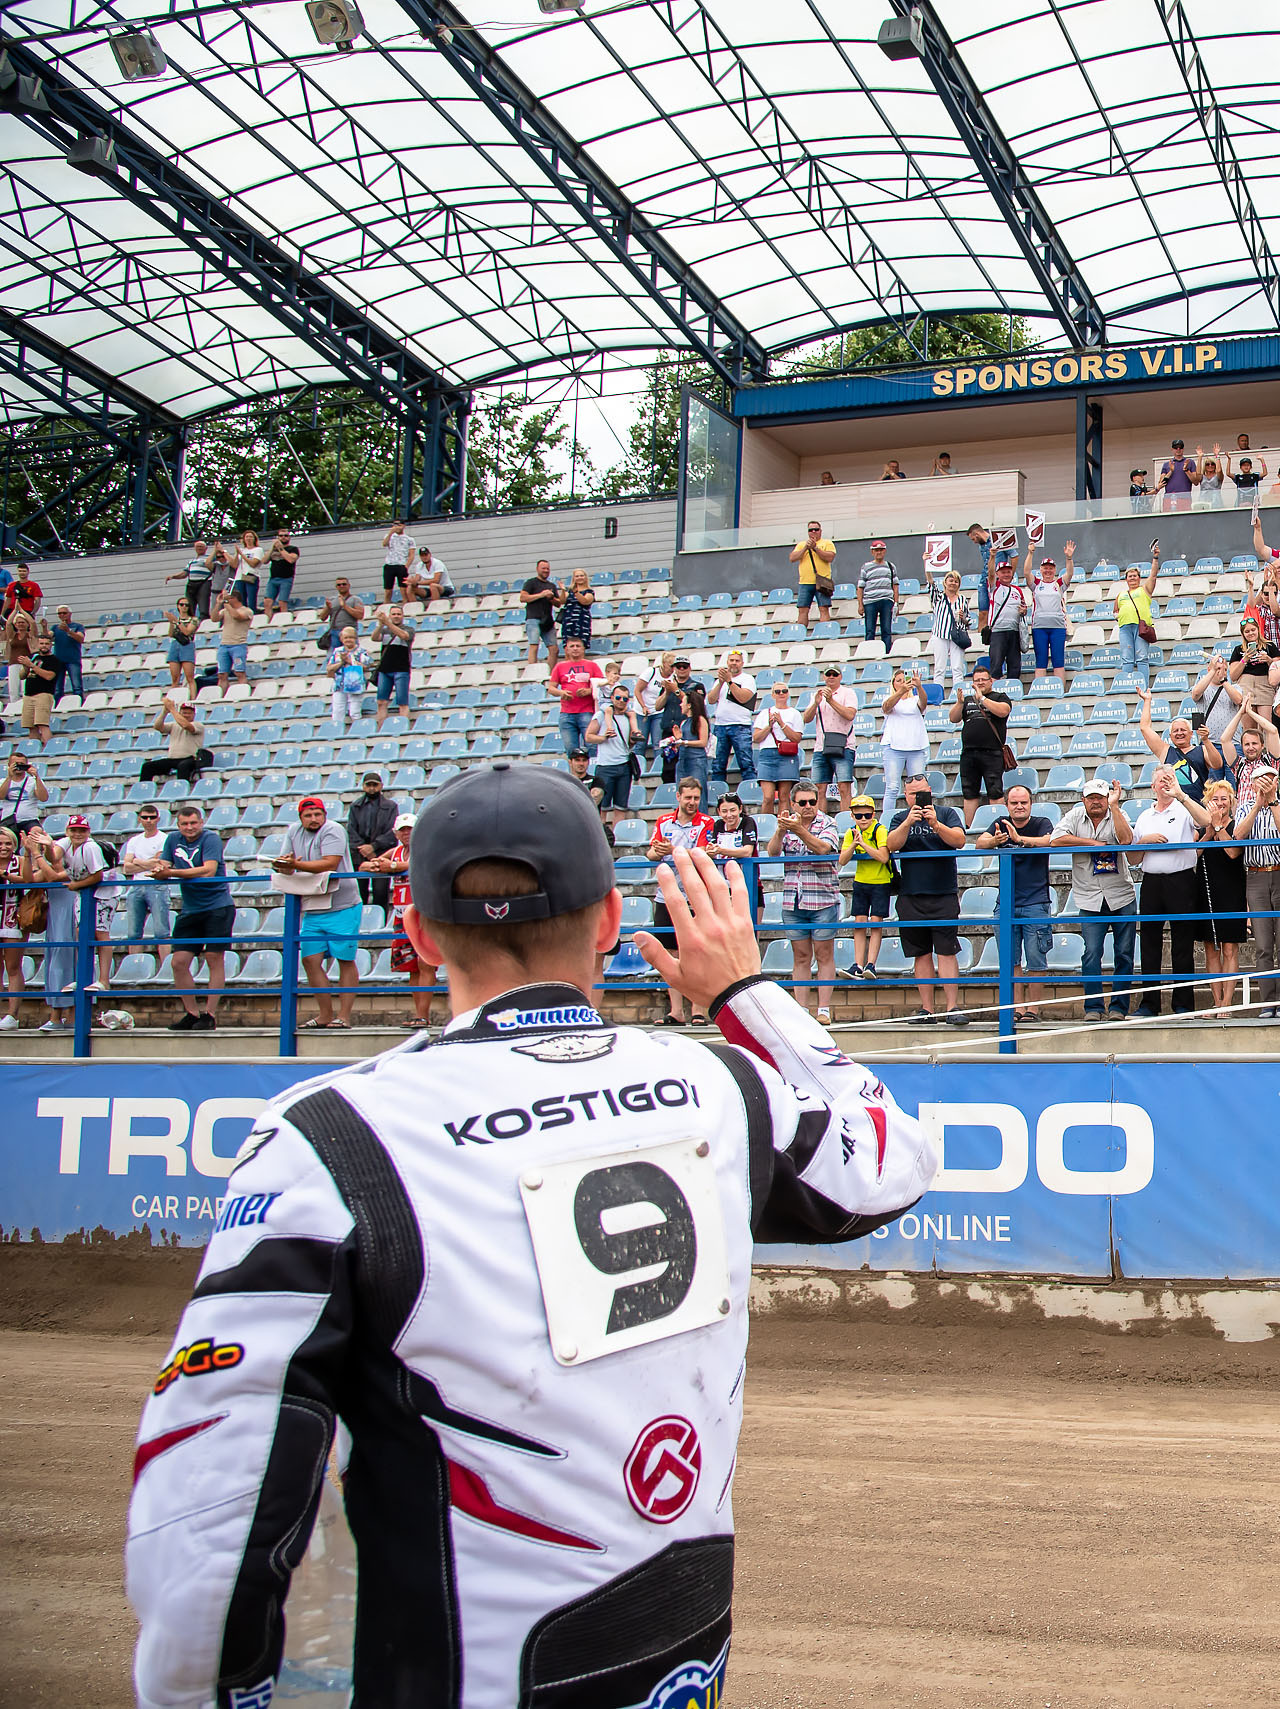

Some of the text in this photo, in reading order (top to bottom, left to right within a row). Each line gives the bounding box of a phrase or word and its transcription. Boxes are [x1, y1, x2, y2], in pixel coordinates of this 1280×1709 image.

[932, 344, 1223, 396] SPONSORS V.I.P.
[604, 516, 618, 539] D
[568, 665, 587, 674] ATL
[131, 1195, 179, 1219] CAR
[899, 1214, 1011, 1242] ONLINE
[574, 1161, 698, 1335] 9
